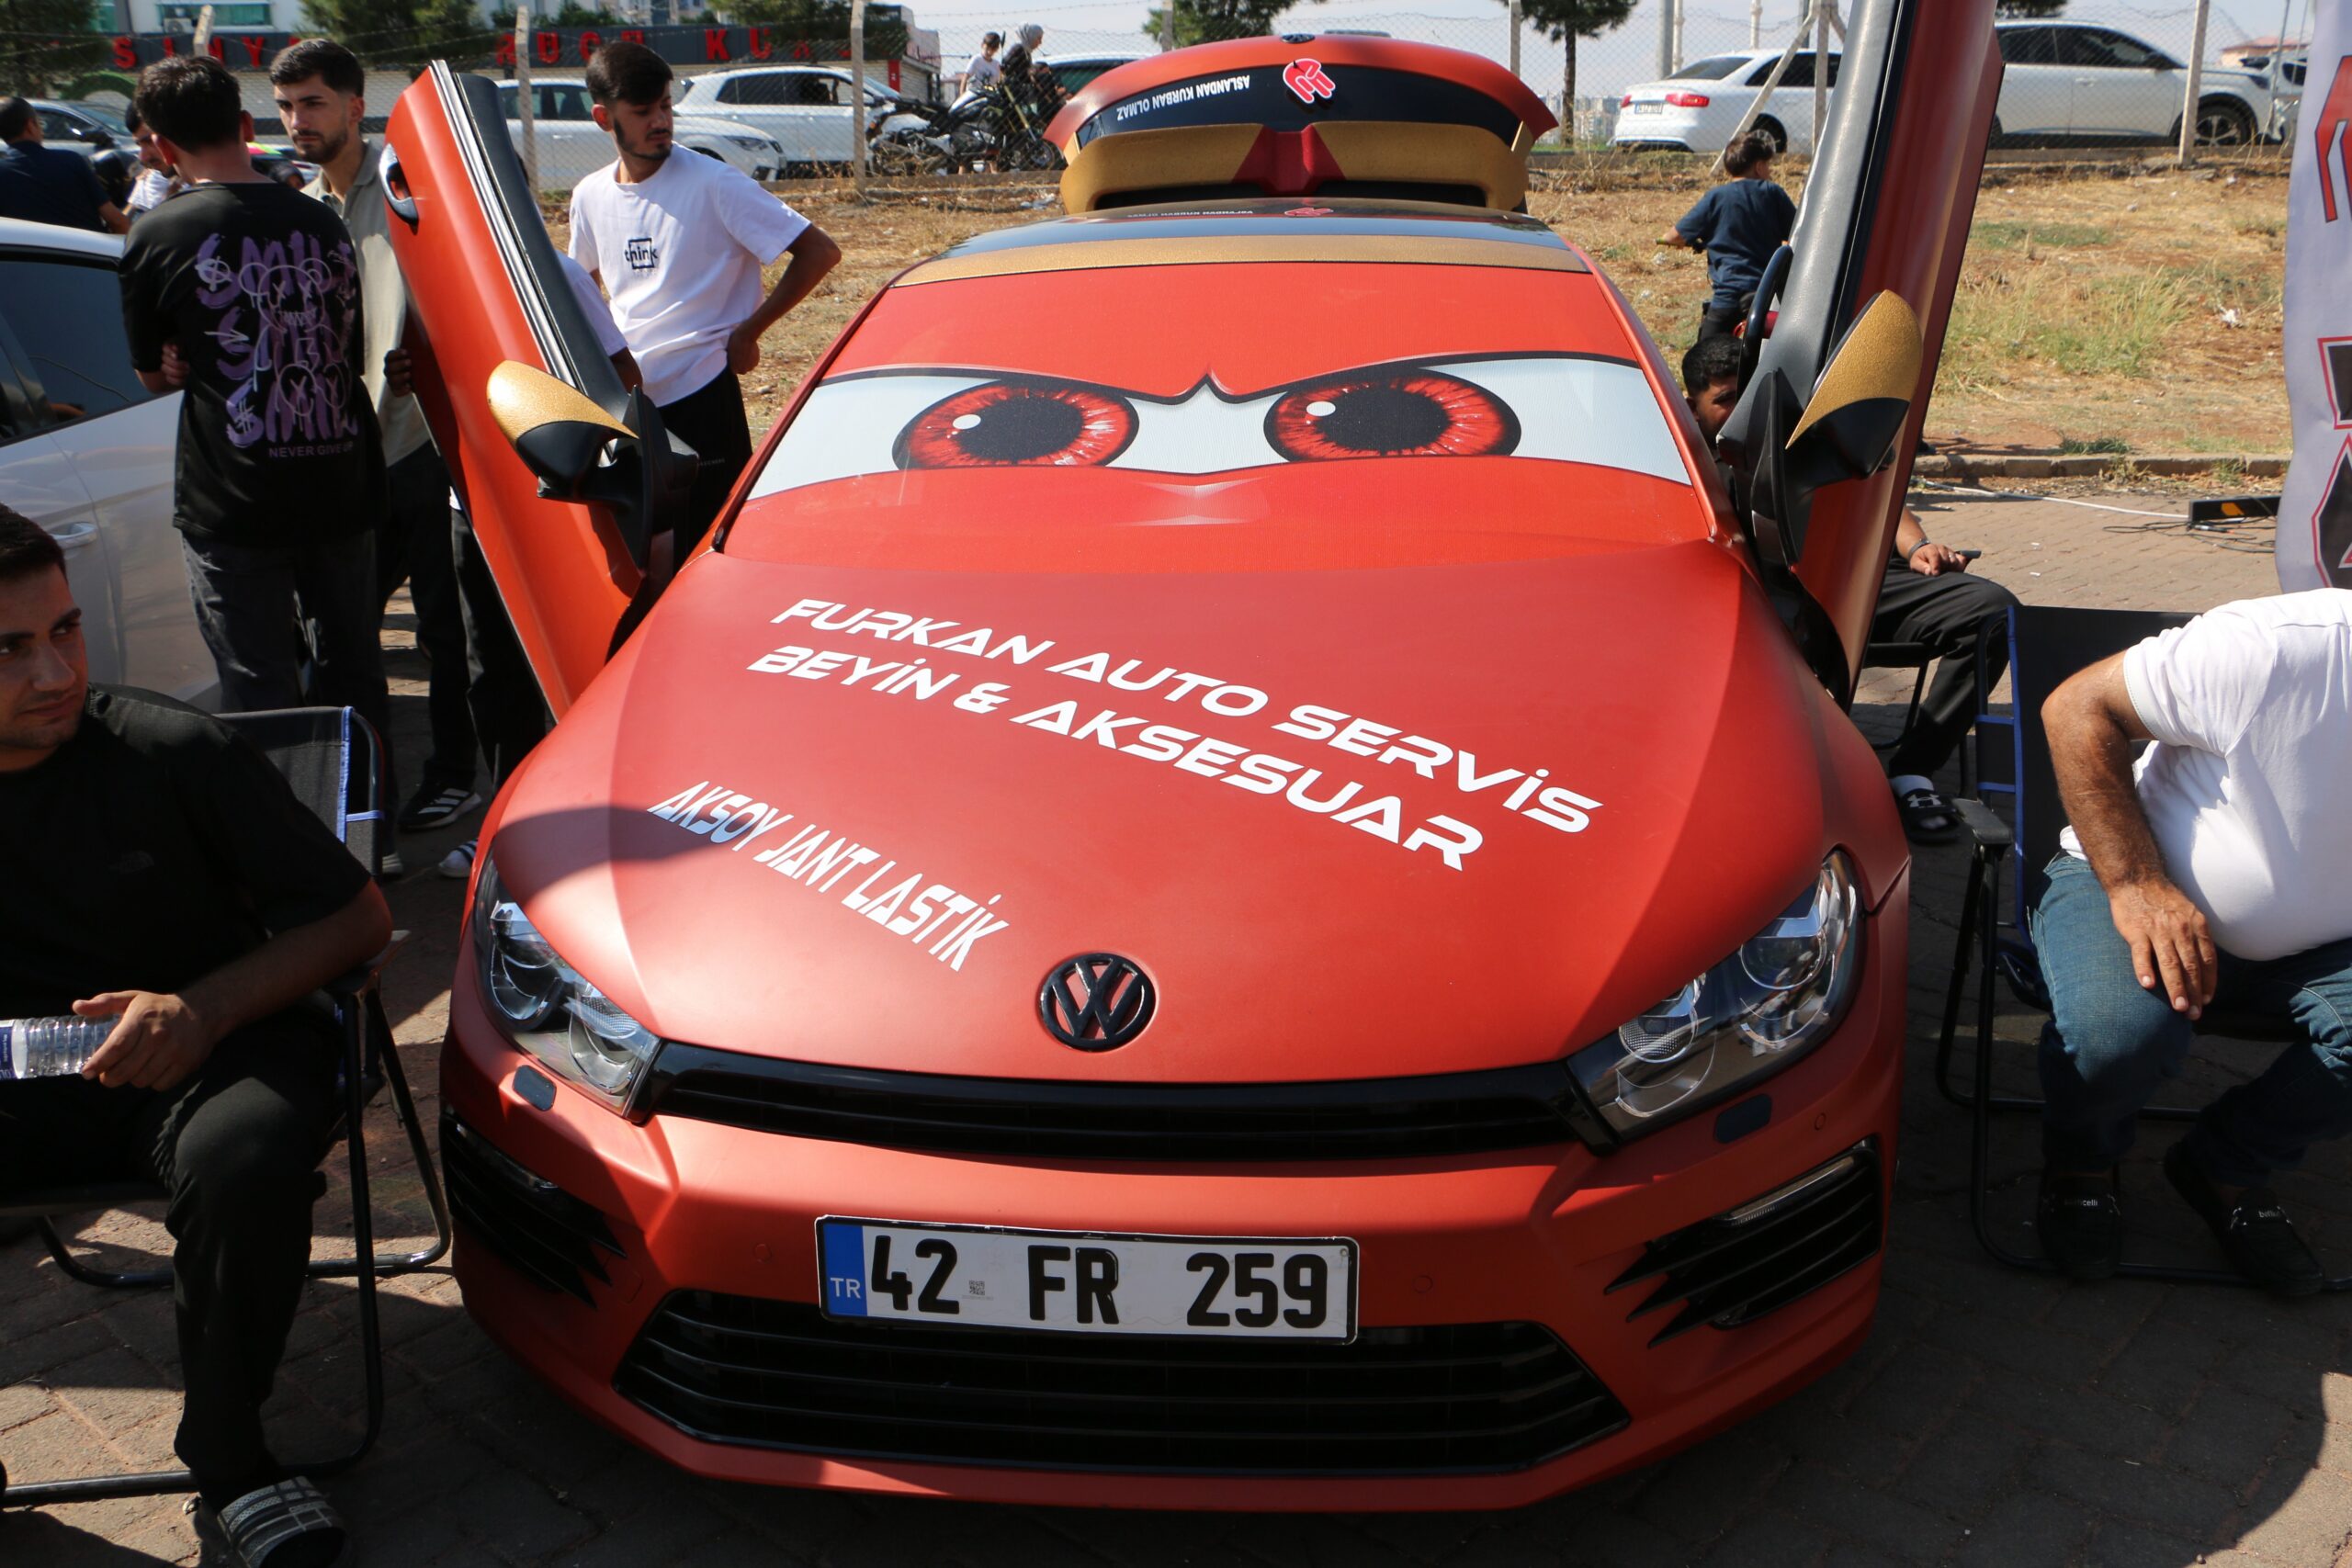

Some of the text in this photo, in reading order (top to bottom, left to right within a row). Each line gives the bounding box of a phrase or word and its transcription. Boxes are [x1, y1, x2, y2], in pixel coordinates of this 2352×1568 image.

[1116, 74, 1250, 121] ASLANDAN KURBAN OLMAZ
[625, 241, 658, 265] think
[268, 446, 314, 458] NEVER
[317, 443, 342, 456] GIVE
[770, 599, 1603, 833] FURKAN AUTO SERVİS
[953, 682, 1012, 715] &
[1010, 700, 1483, 871] AKSESUAR
[646, 781, 1010, 972] AKSOY JANT LASTİK
[1040, 953, 1156, 1051] VW
[831, 1235, 1328, 1329] TR 42 FR 259
